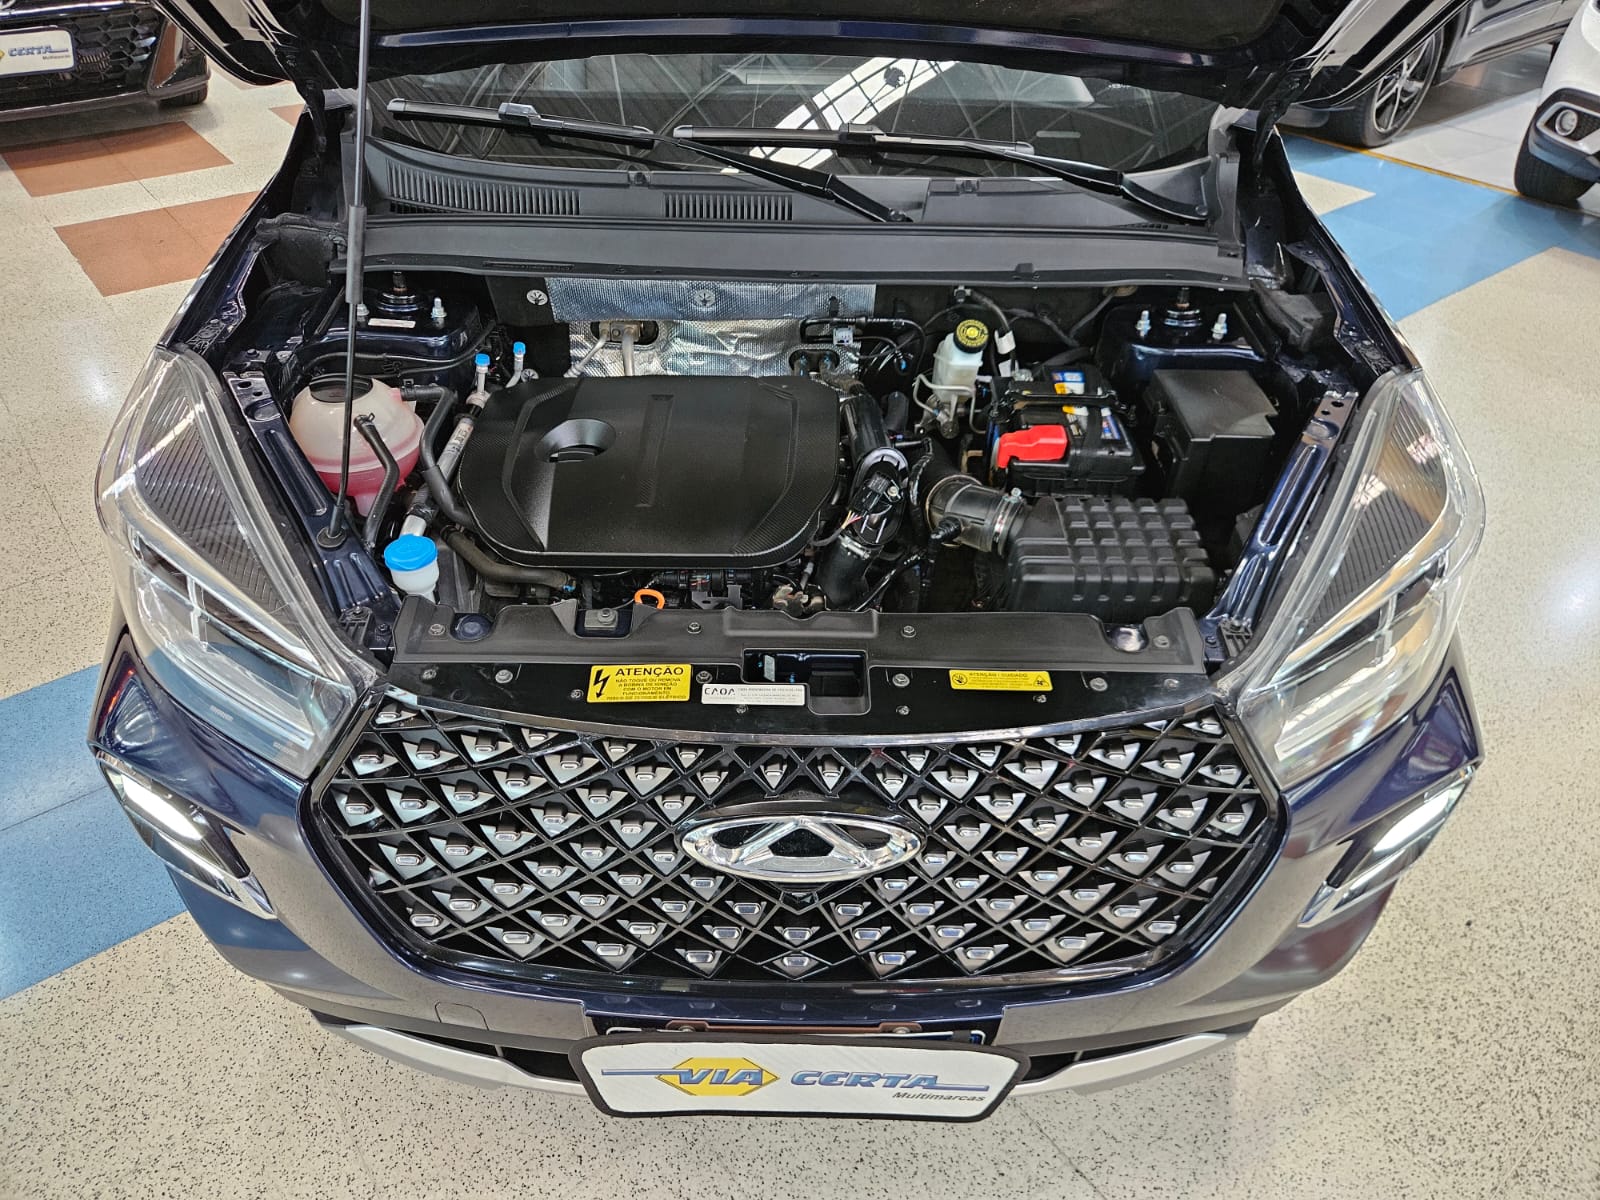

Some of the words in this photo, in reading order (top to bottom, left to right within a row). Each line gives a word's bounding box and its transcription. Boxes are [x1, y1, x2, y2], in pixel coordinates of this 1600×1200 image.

[615, 666, 683, 677] ATENÇÃO
[704, 687, 735, 696] CAOA
[678, 1068, 763, 1086] VIA
[790, 1070, 938, 1088] CERTA
[892, 1091, 986, 1102] Multimarcas
